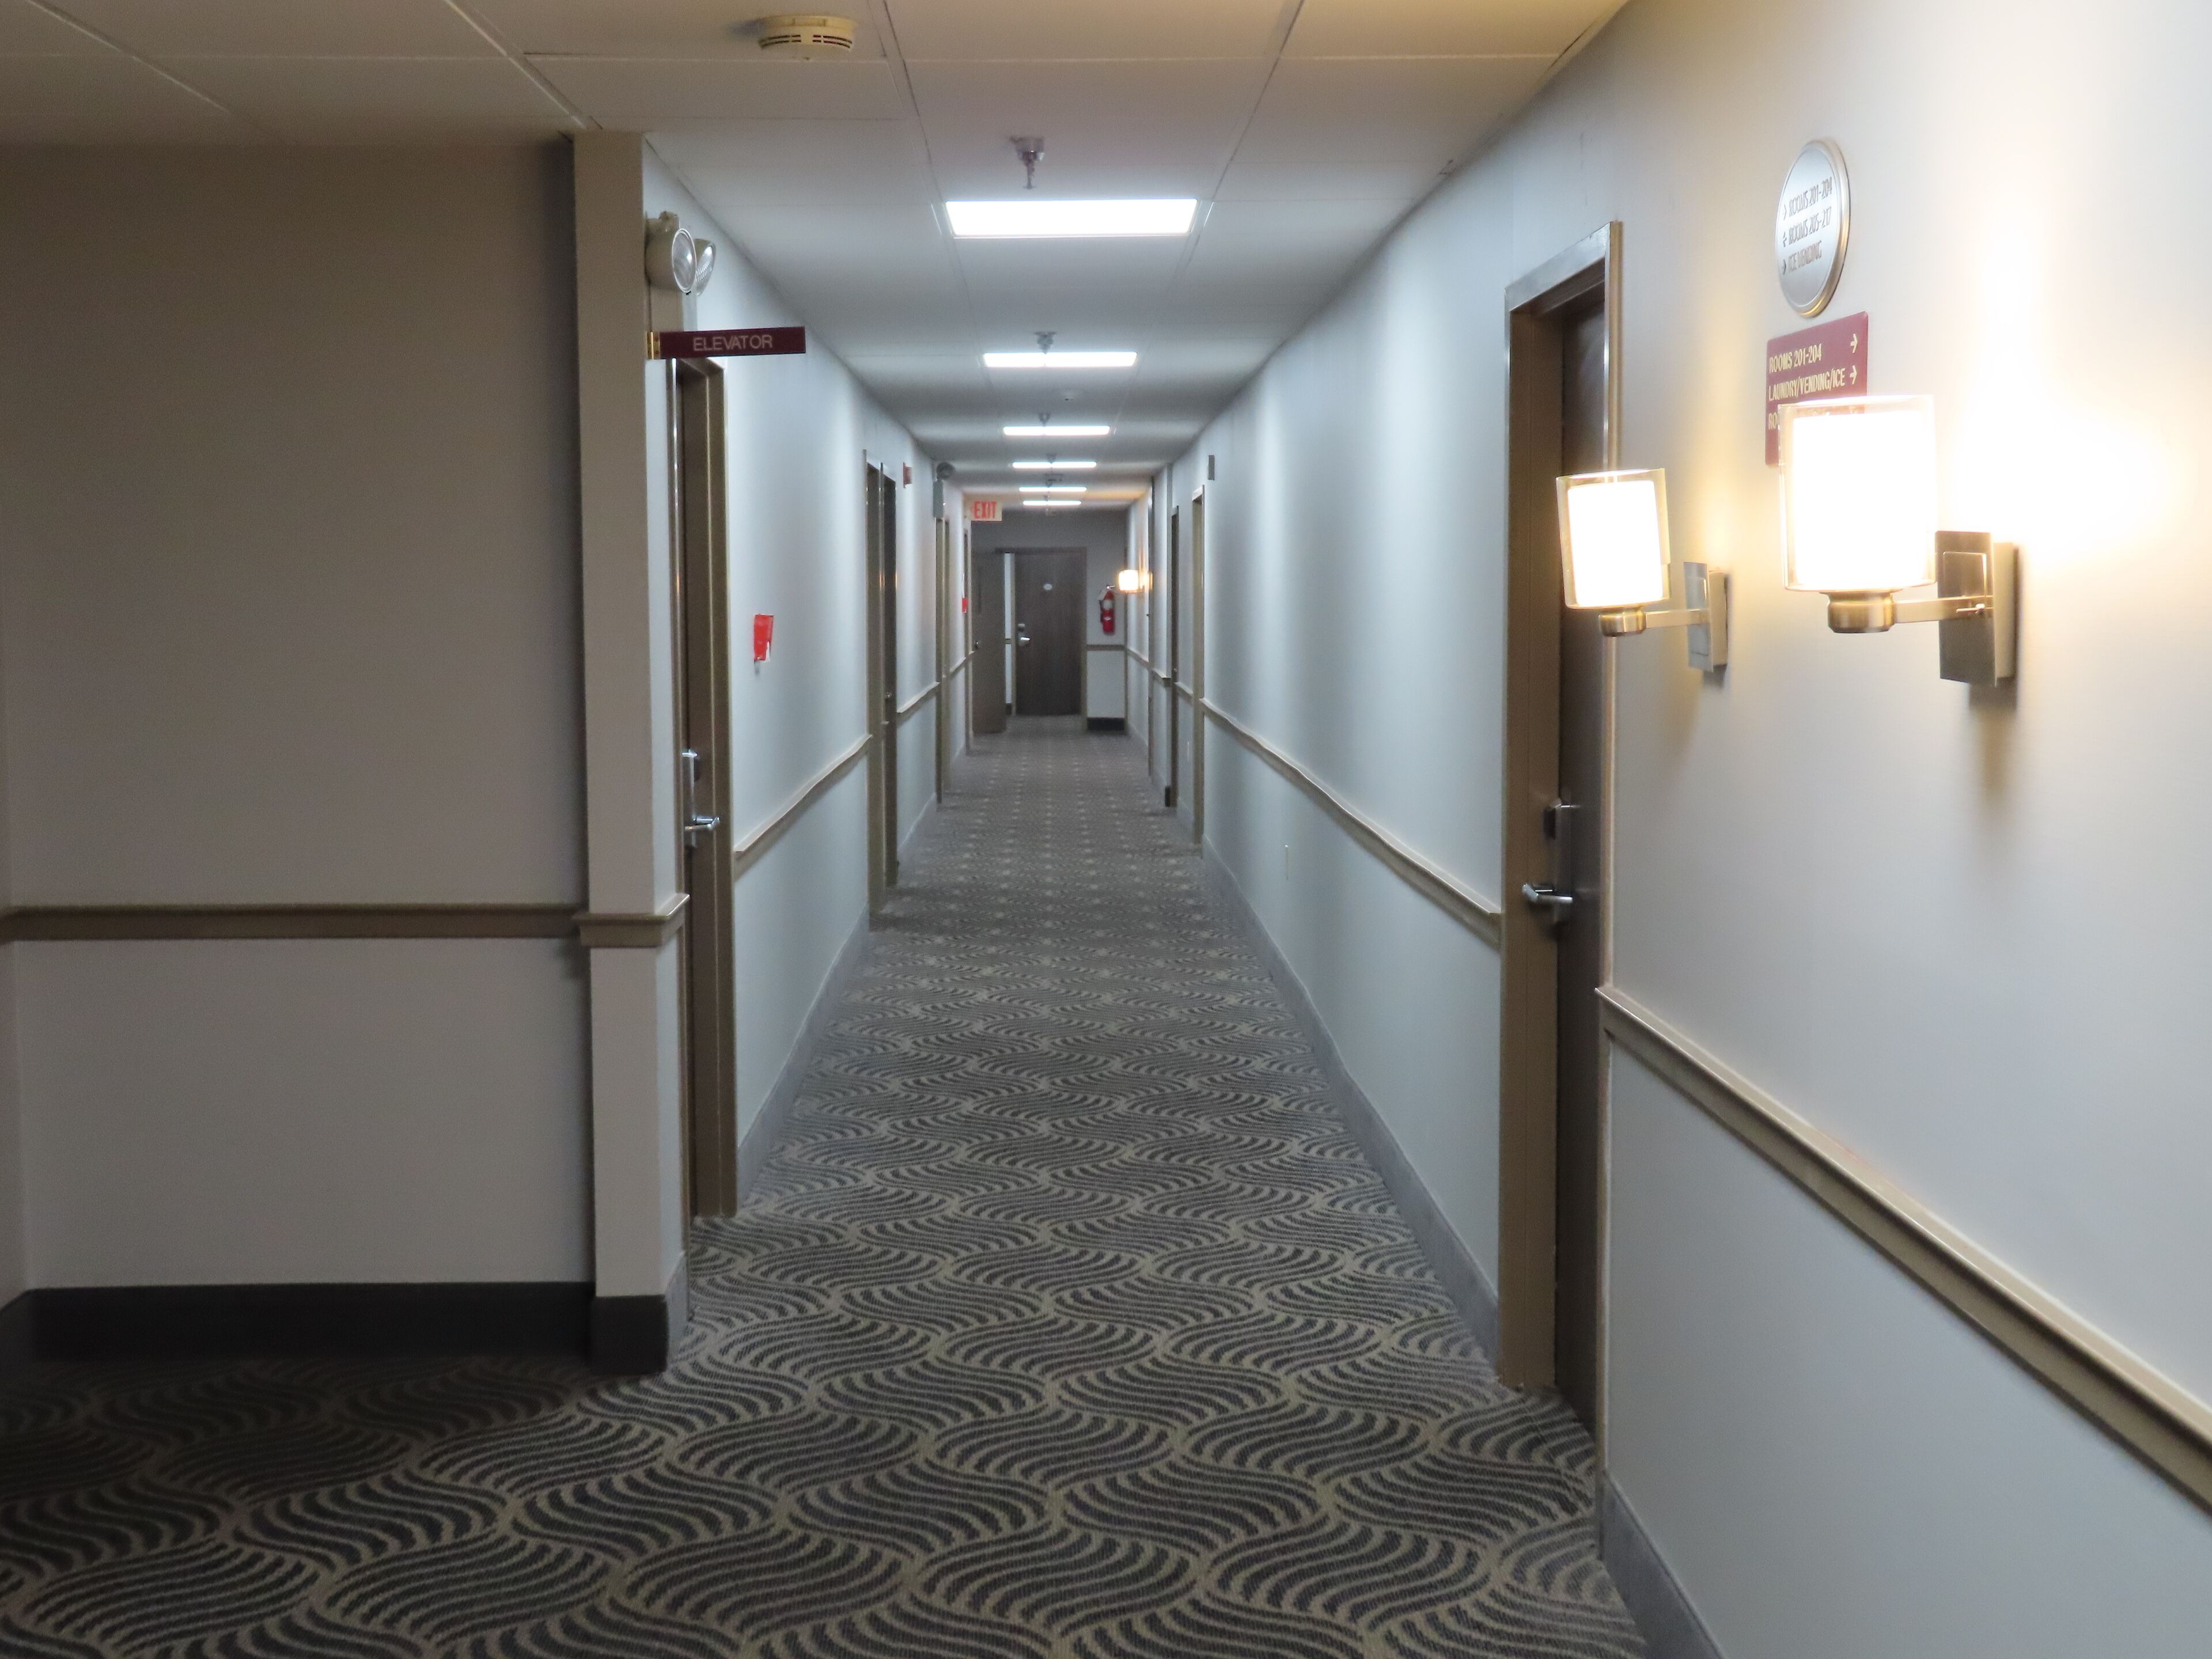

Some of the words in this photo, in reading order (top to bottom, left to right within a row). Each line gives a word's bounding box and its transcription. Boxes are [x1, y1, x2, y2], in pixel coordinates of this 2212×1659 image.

[1789, 190, 1808, 217] ROOMS
[1809, 176, 1832, 206] 201-204
[1788, 219, 1808, 245] ROOMS
[693, 334, 773, 351] ELEVATOR
[1769, 351, 1793, 373] ROOMS
[1794, 343, 1822, 368] 201-204
[1768, 368, 1846, 402] LAUNDRY/VENDING/ICE
[974, 501, 997, 519] EXIT
